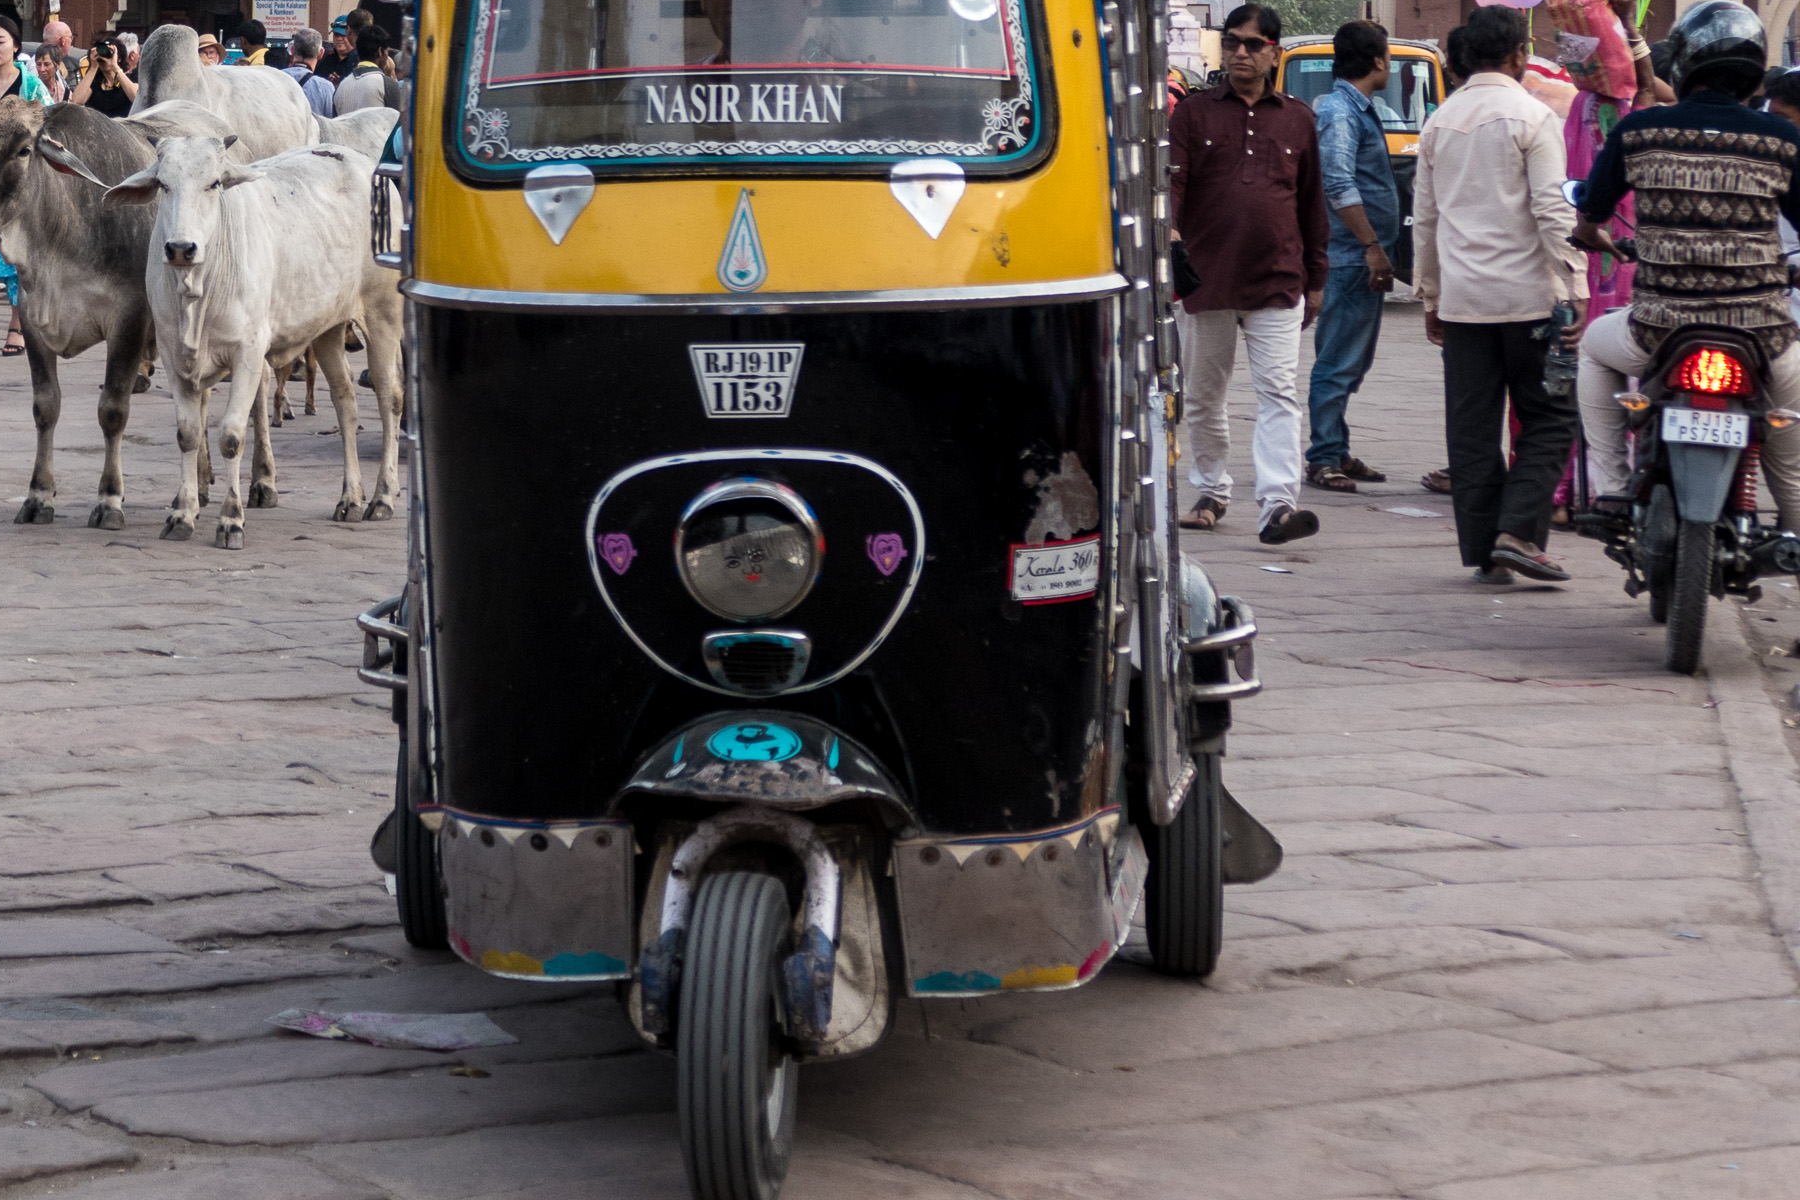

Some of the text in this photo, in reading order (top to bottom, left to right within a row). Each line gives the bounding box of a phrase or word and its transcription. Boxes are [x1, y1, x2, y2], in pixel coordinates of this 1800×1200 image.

[646, 84, 844, 123] NASIR KHAN
[712, 381, 783, 411] 1153
[1691, 411, 1733, 428] RJ19
[1679, 425, 1742, 444] PS7503
